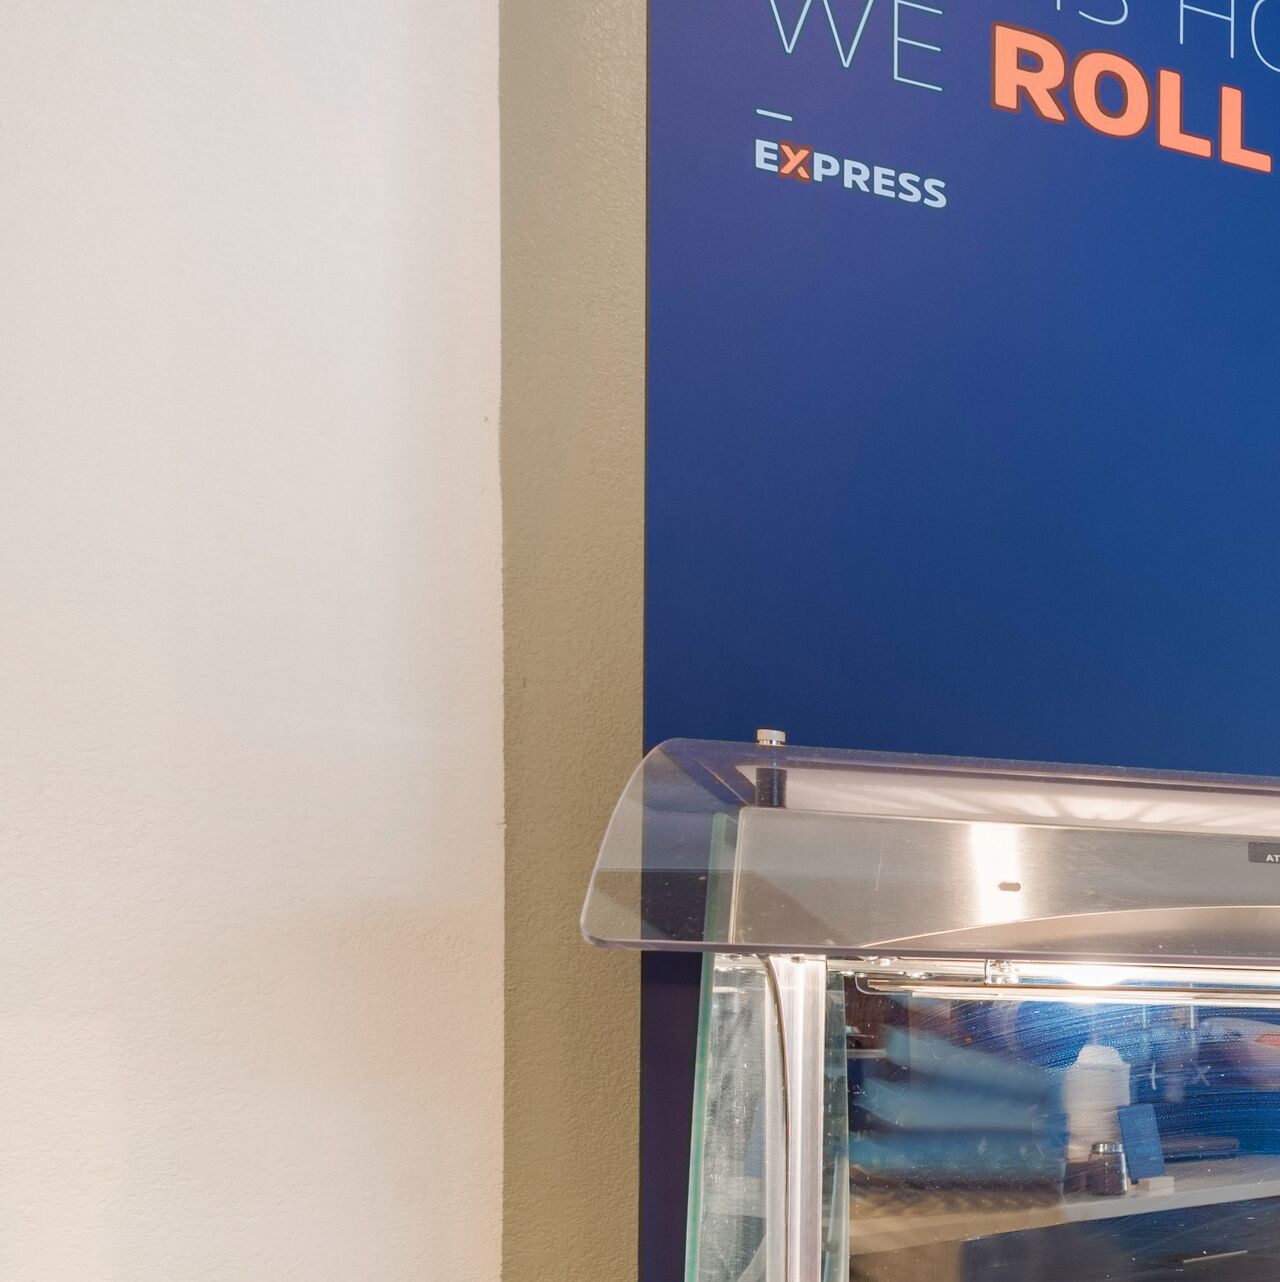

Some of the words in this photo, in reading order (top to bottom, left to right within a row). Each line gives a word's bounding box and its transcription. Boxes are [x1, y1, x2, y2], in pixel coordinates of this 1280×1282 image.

[769, 0, 943, 92] WE
[994, 24, 1273, 174] ROLL
[755, 139, 948, 209] EXPRESS
